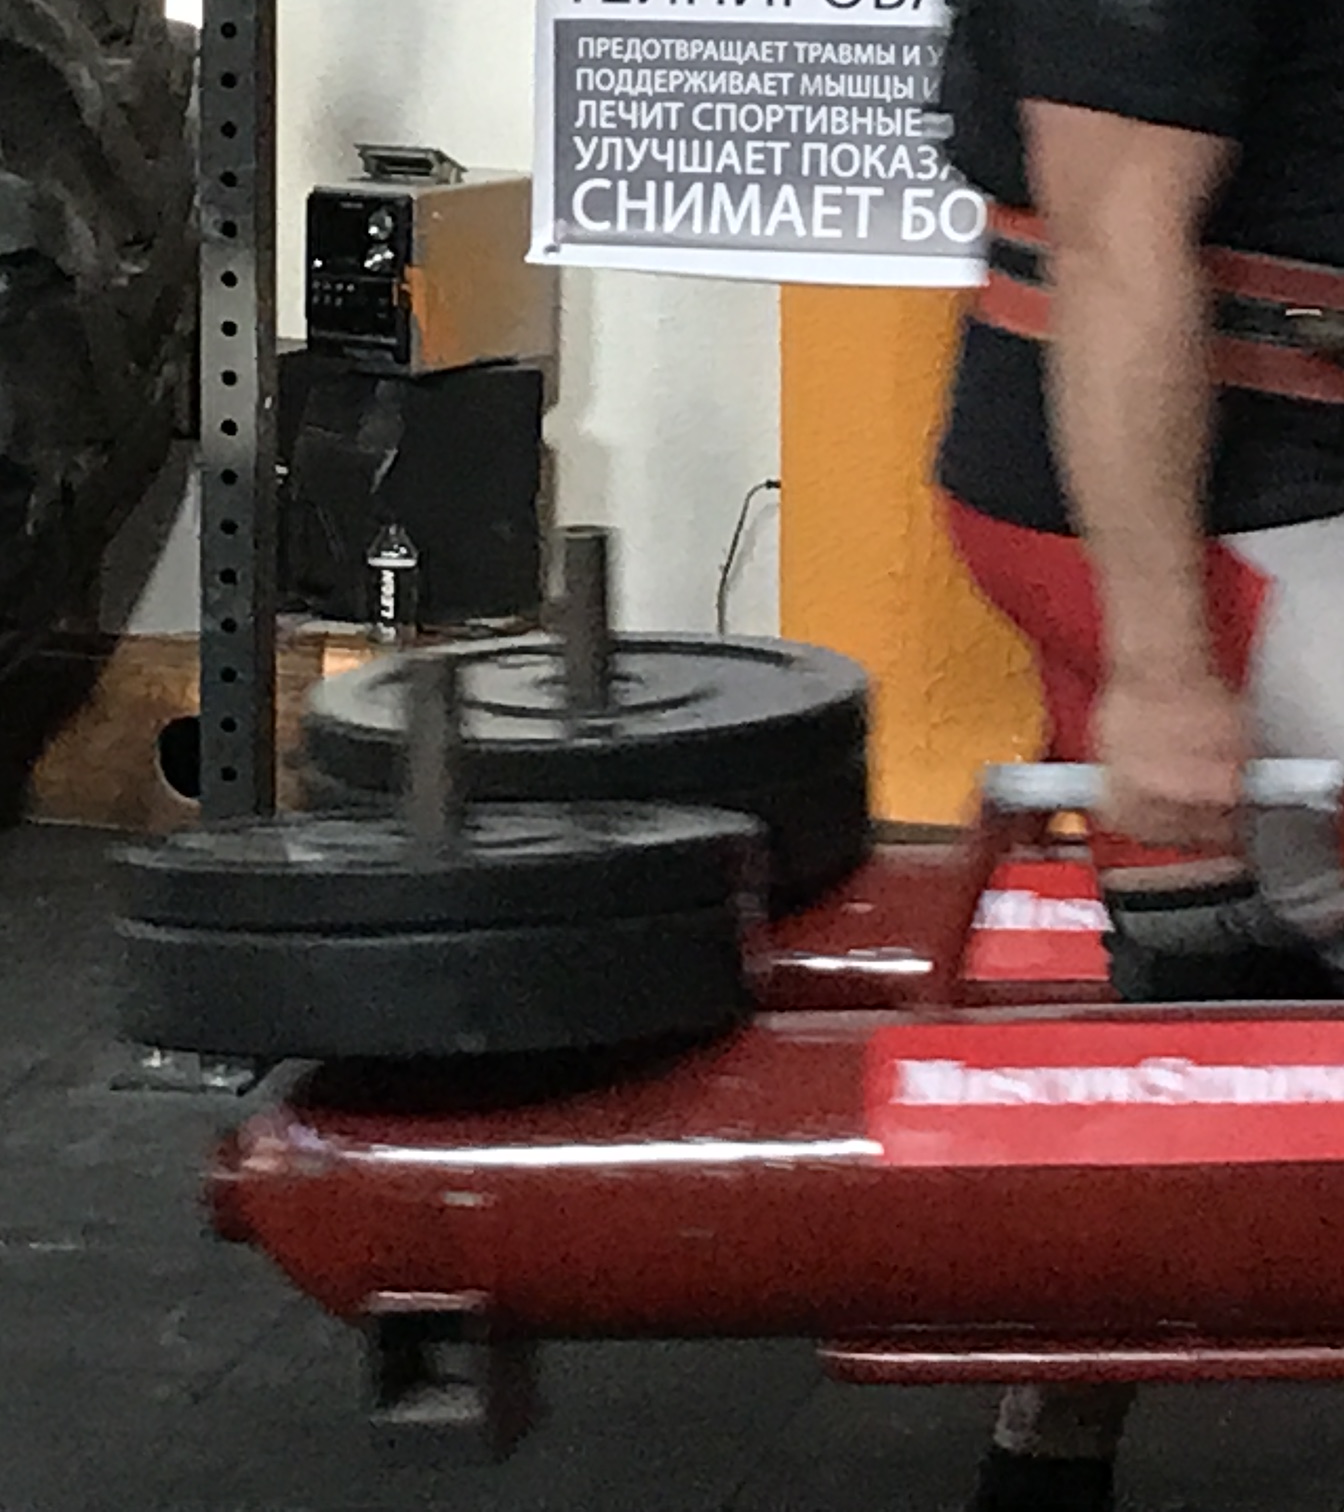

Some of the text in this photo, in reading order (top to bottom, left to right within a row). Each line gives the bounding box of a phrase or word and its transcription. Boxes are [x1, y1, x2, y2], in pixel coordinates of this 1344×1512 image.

[577, 37, 785, 64] ПРЕДОТВРАЩАЕТ
[793, 42, 894, 65] ТРАВМЫ
[902, 47, 920, 65] И
[576, 68, 793, 98] ПОДДЕРЖИВАЕТ
[799, 74, 914, 102] МЫШЦЫ
[574, 100, 683, 130] ЛЕЧИТ
[691, 104, 922, 138] СПОРТИВНЫЕ
[573, 136, 789, 175] УЛУЧШАЕТ
[571, 179, 988, 243] СНИМАЕТ БО
